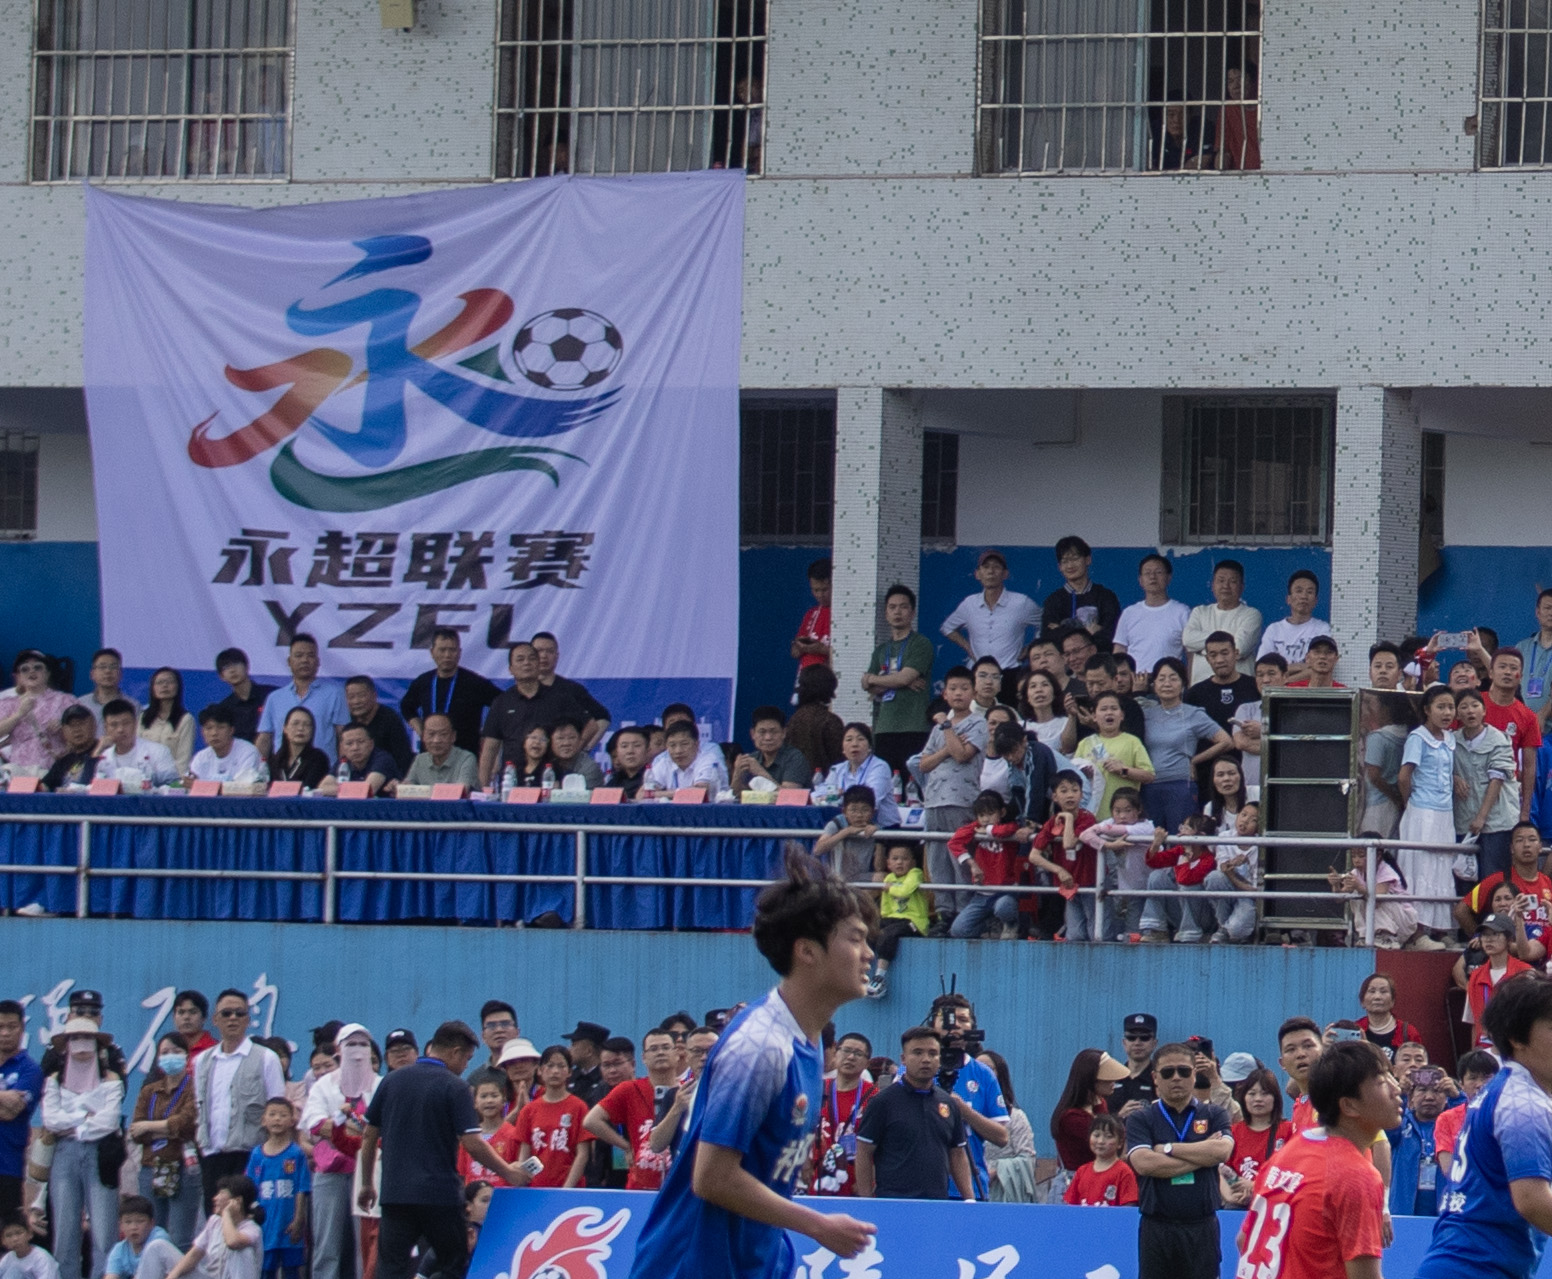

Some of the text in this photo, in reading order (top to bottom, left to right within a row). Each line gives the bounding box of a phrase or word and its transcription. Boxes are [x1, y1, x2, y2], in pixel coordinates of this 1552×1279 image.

[213, 528, 596, 590] 永超联赛
[531, 1128, 569, 1152] 零陵
[259, 1180, 294, 1199] 零陵
